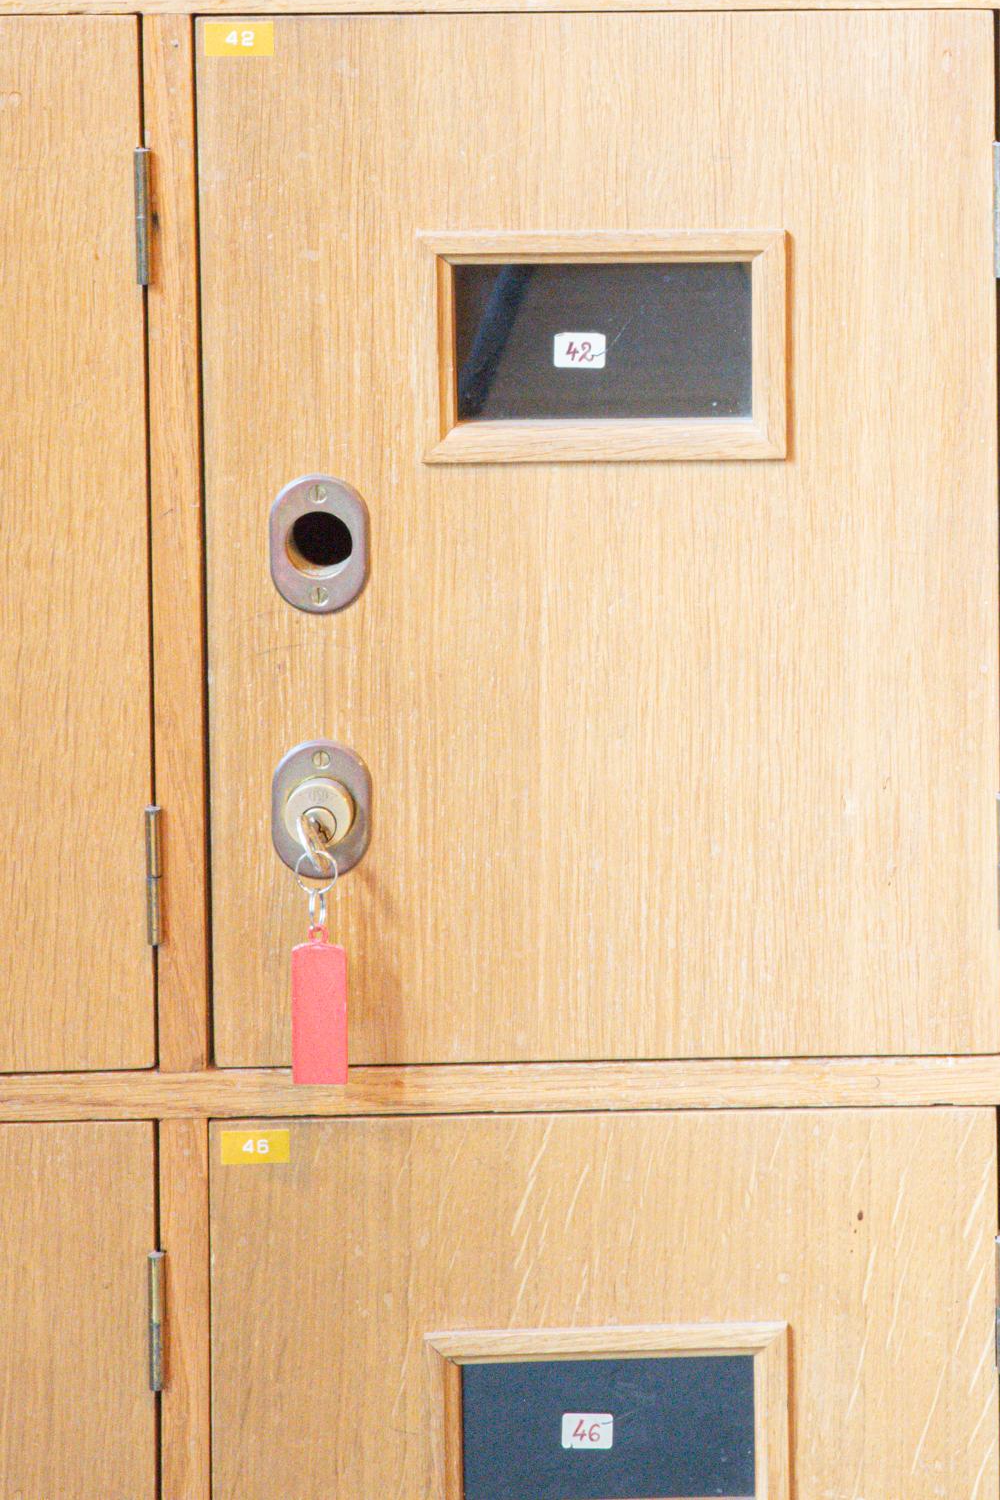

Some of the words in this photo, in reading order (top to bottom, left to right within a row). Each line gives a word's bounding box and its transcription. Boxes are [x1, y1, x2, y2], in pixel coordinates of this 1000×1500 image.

[224, 30, 255, 47] 42
[565, 341, 596, 363] 42
[242, 1138, 270, 1155] 46
[572, 1418, 601, 1443] 46
